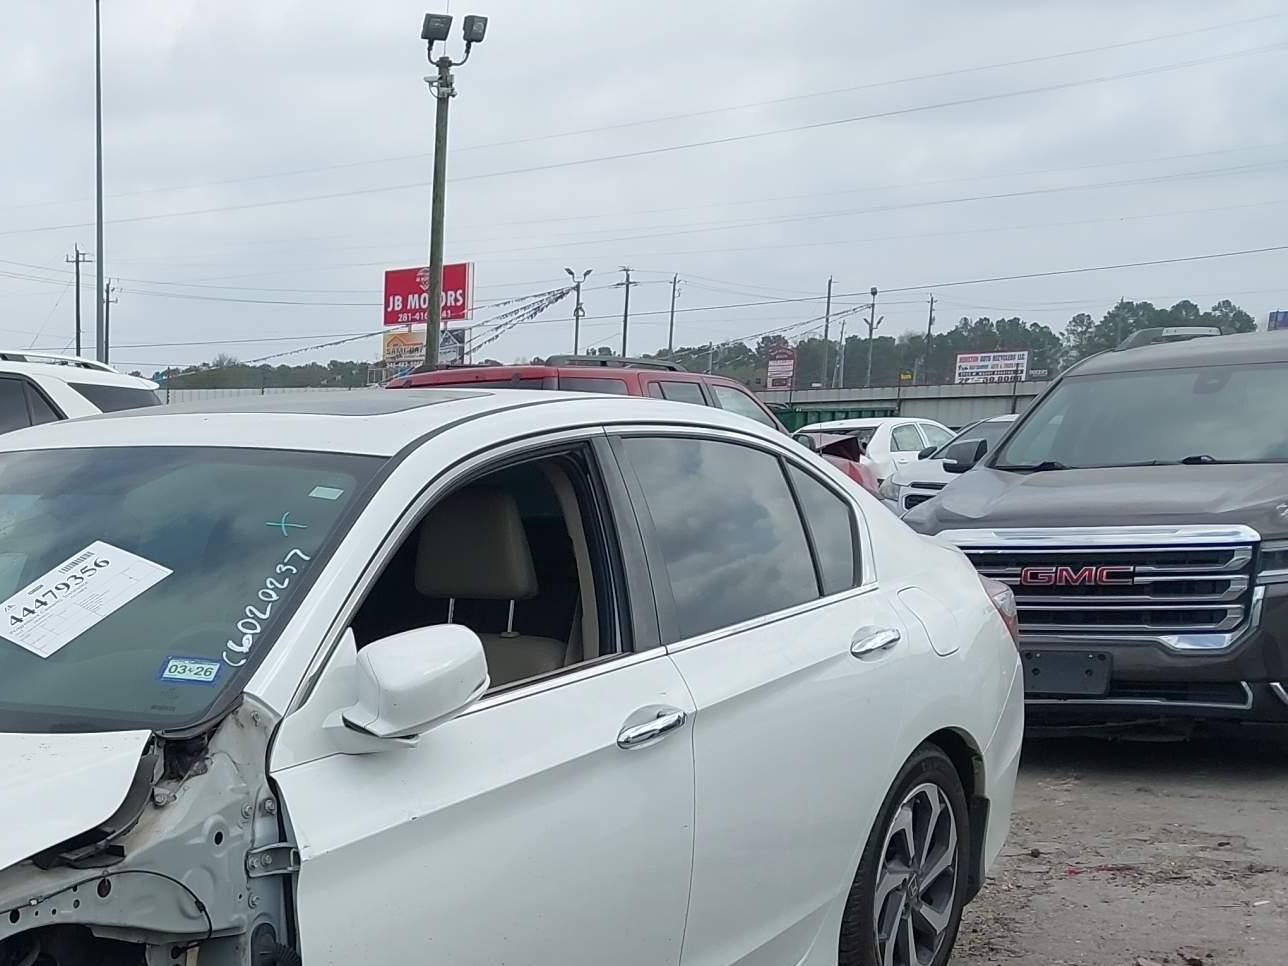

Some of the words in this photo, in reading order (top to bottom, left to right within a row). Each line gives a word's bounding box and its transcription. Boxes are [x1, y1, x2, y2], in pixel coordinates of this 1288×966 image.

[387, 295, 403, 312] JB
[407, 289, 463, 310] MOORS
[1021, 566, 1133, 585] GMC
[9, 558, 110, 627] 44479356
